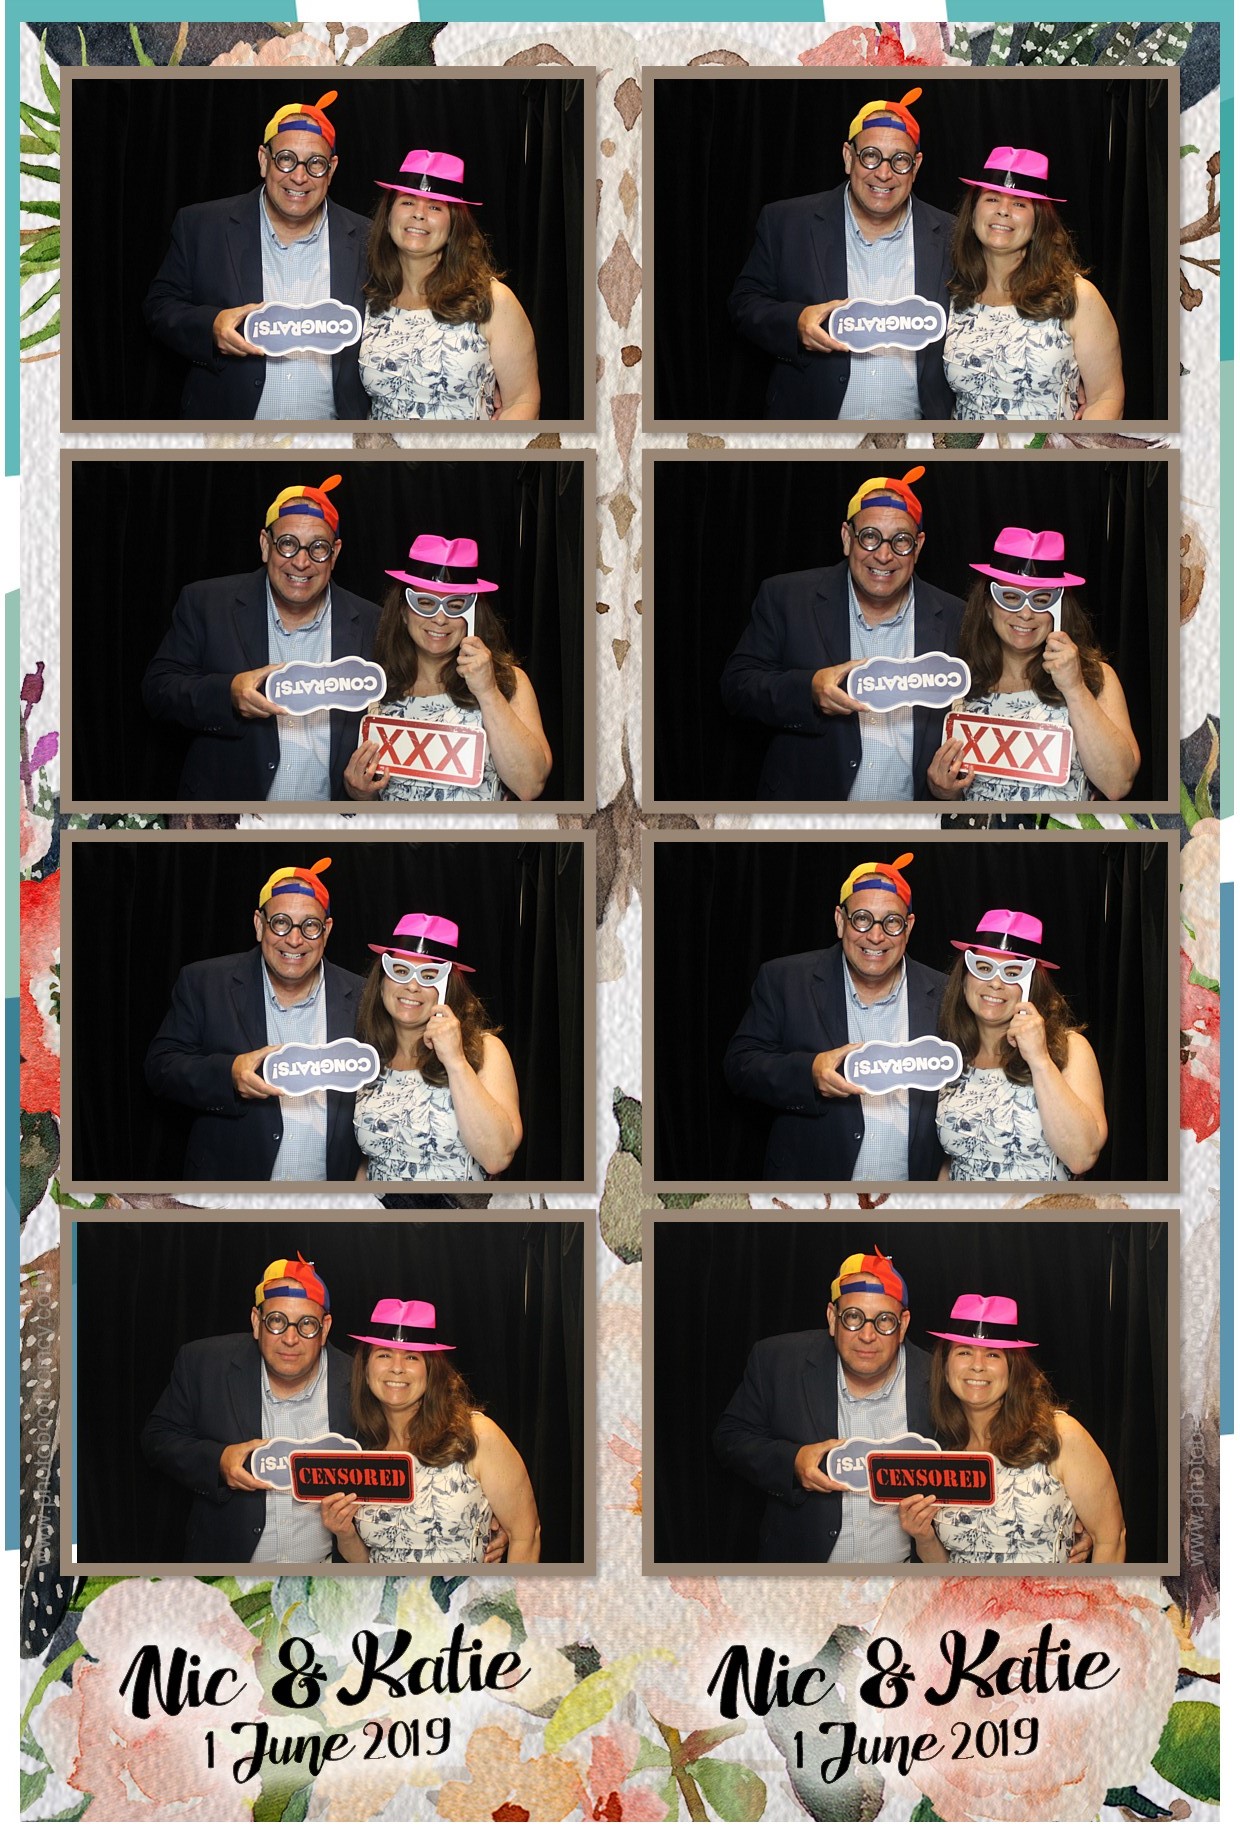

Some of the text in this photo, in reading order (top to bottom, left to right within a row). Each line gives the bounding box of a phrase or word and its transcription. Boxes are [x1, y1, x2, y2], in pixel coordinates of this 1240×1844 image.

[252, 318, 354, 338] CONGRATS!
[837, 315, 938, 334] CONGRATS!
[274, 675, 378, 698] CONGRATS!
[856, 671, 962, 695] CONGRATS!
[375, 726, 470, 775] XXX
[959, 723, 1056, 773] XXX
[272, 1057, 372, 1079] CONGRATS!
[852, 1055, 954, 1078] CONGRATS!
[299, 1467, 406, 1487] CENSORED
[876, 1468, 987, 1488] CENSORED
